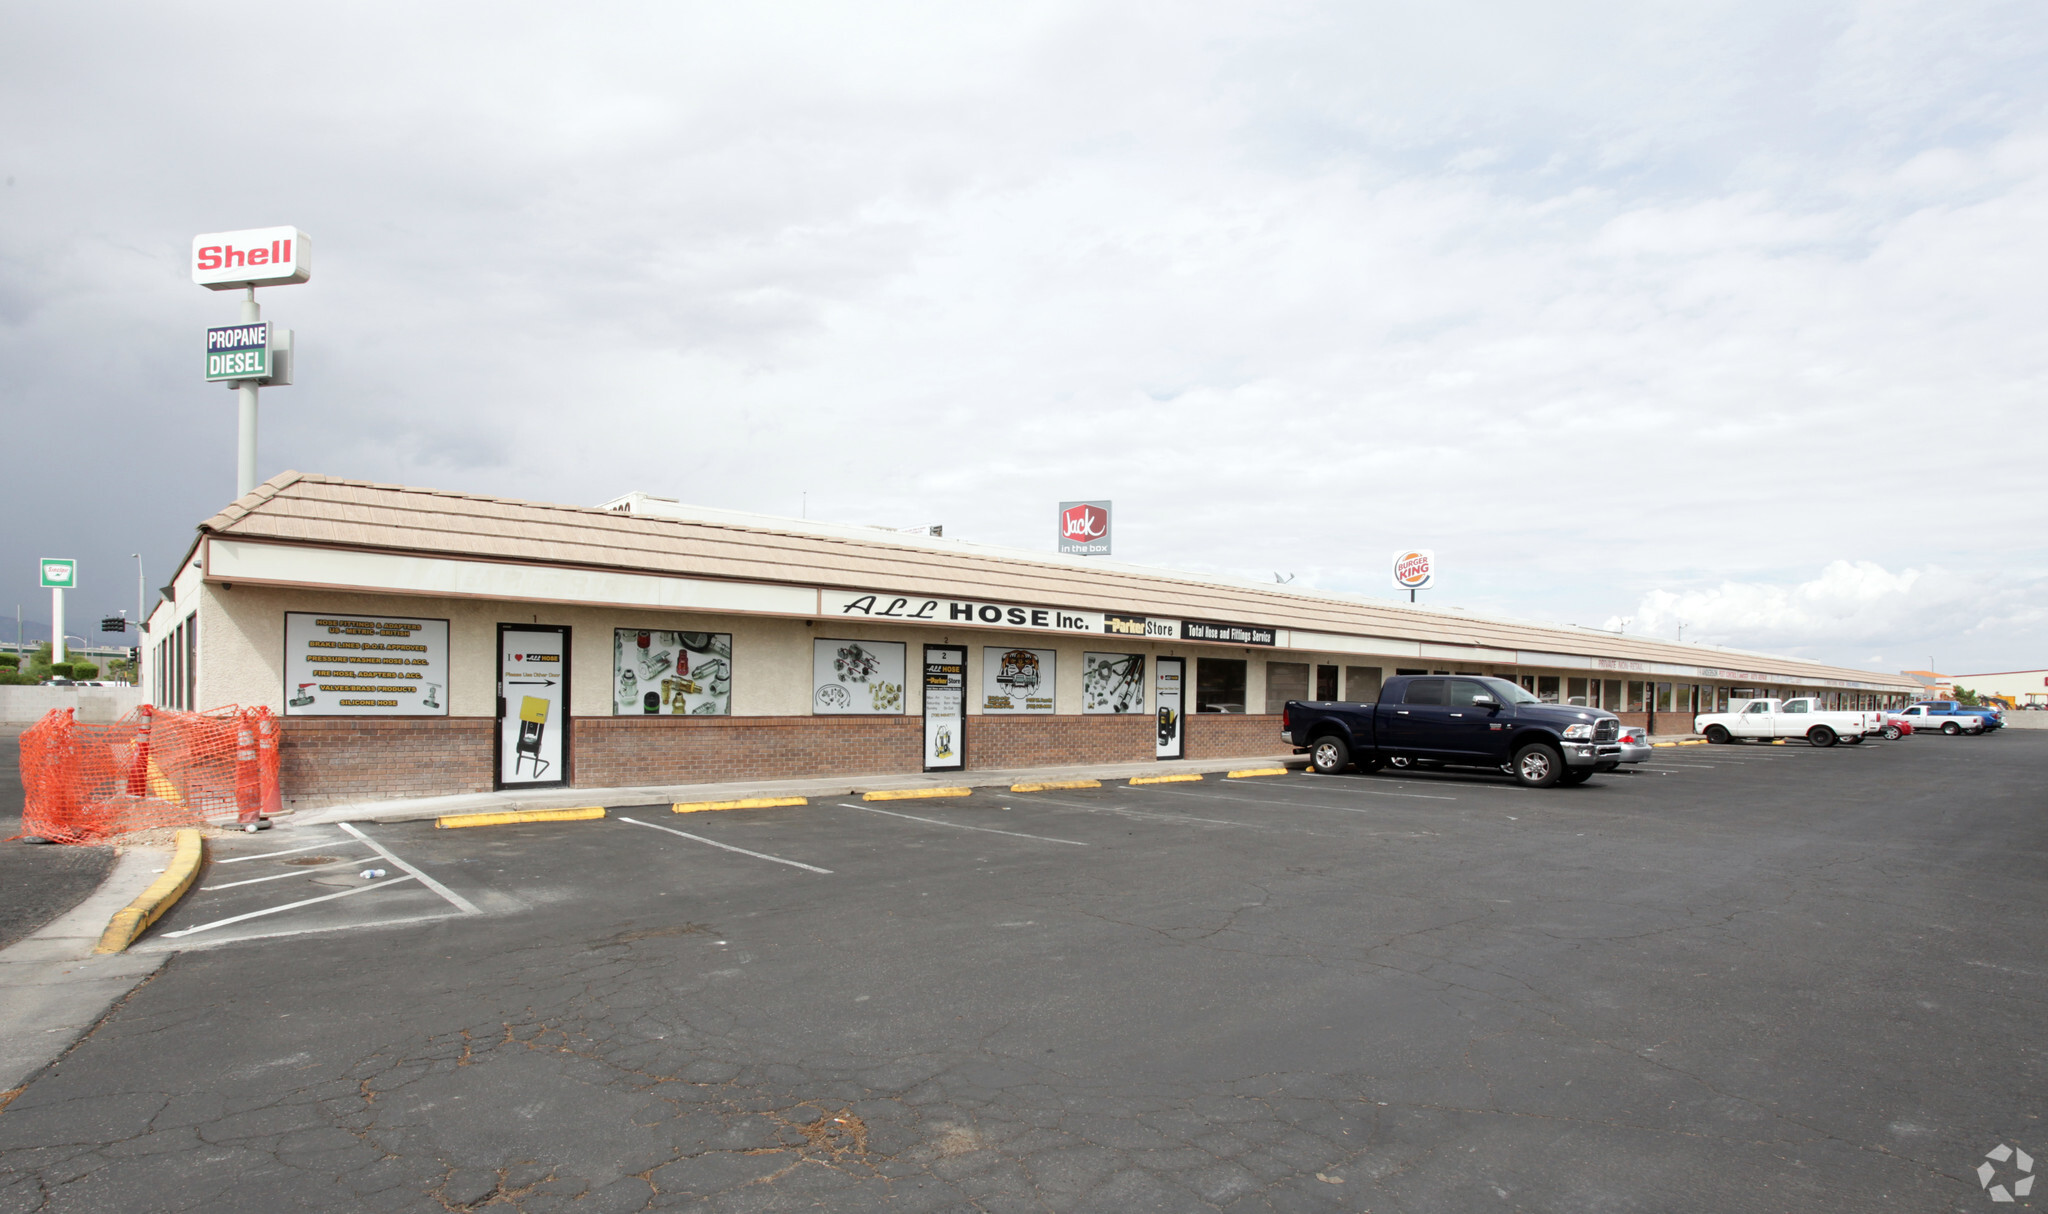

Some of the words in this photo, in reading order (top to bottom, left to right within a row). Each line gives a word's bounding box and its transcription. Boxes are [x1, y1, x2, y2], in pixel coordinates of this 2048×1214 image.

[197, 239, 291, 270] Shell
[208, 326, 266, 350] PROPANE
[209, 351, 263, 375] DIESEL
[1063, 508, 1106, 537] Jack
[1090, 544, 1108, 552] box
[1398, 556, 1428, 571] BURGER
[1400, 563, 1429, 581] KING
[843, 595, 938, 619] ALL
[950, 602, 1049, 627] HOSE
[1056, 611, 1089, 630] Inc.
[339, 620, 375, 628] FITTINGS
[383, 623, 422, 631] ADAPTERS
[345, 628, 375, 636] METRIC
[1111, 617, 1146, 634] Parker
[1146, 620, 1173, 636] Store
[943, 636, 949, 644] 2
[1188, 624, 1204, 637] Total
[1205, 626, 1218, 639] Hose
[1219, 628, 1230, 639] and
[1231, 628, 1251, 643] Fittings
[1252, 630, 1271, 643] Service
[309, 640, 336, 648] BRAKE
[337, 641, 360, 649] LINES
[386, 643, 427, 653] APPROVED)
[306, 655, 348, 663] PRESSURE
[349, 656, 381, 664] WASHER
[382, 657, 403, 665] HOSE
[411, 658, 429, 666] ACC.
[1598, 658, 1616, 669] PRIVATE
[313, 669, 331, 677] FIRE
[332, 670, 357, 678] HOSE,
[377, 685, 417, 693] PRODUCTS
[377, 699, 398, 707] HOSE
